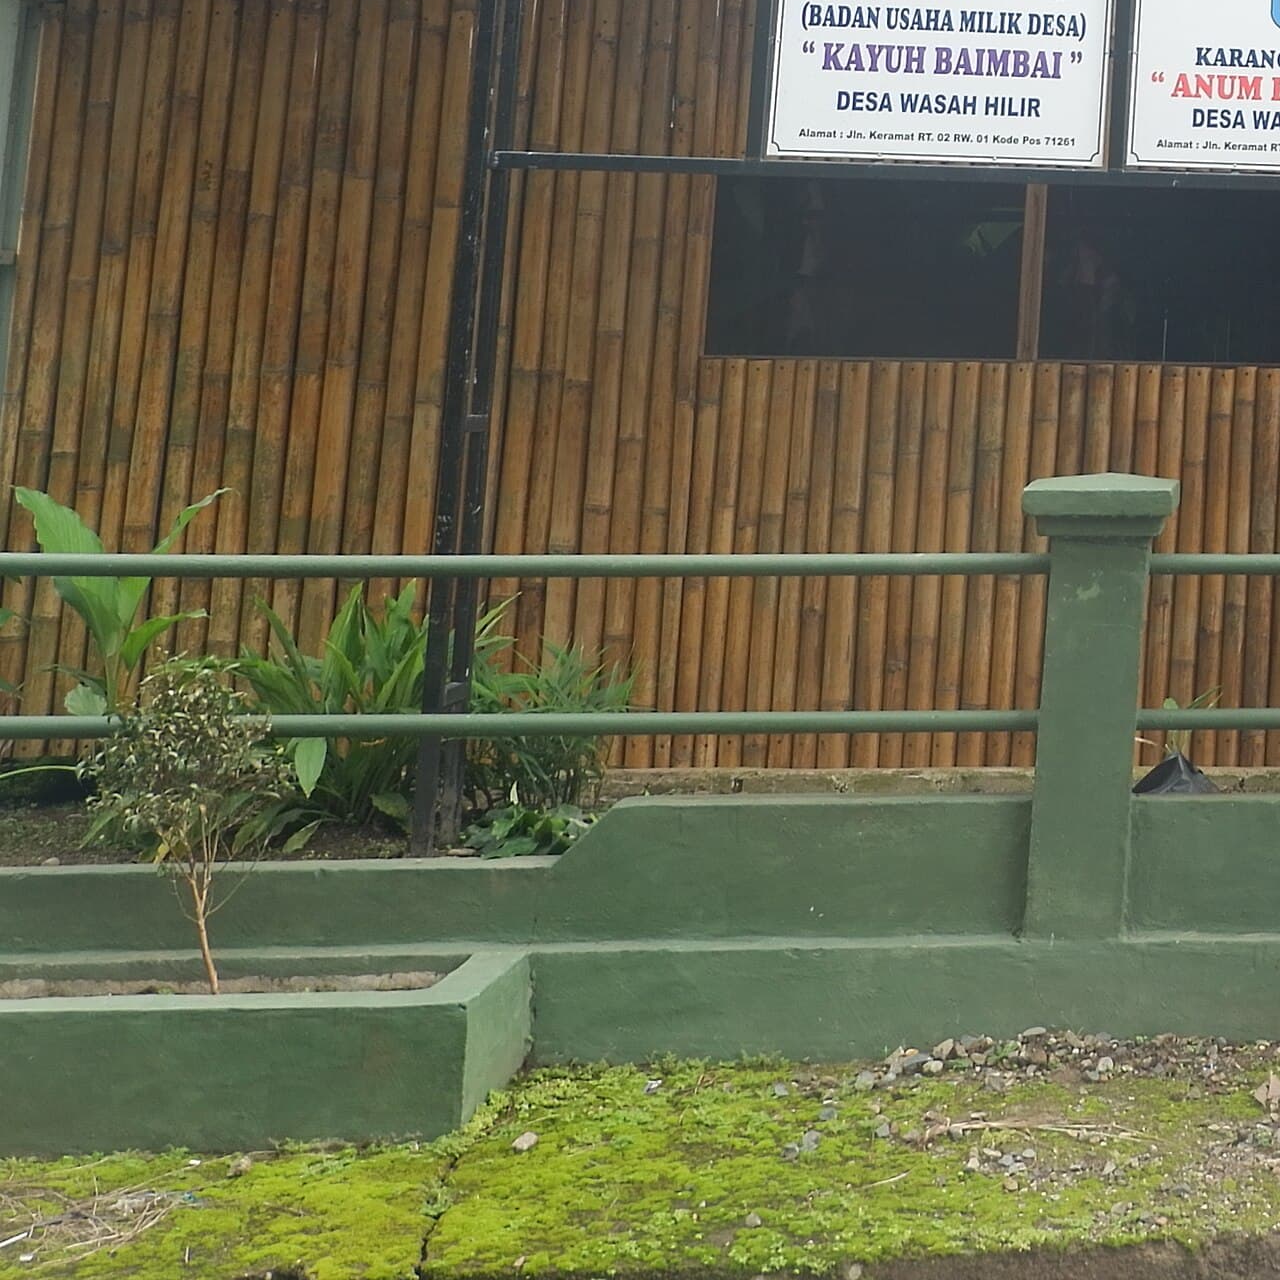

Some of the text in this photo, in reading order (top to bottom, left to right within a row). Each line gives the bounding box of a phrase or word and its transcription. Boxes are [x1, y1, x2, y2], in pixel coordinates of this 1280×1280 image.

[801, 1, 1087, 43] (BADAN USAHA MILIK DESA)
[821, 42, 1063, 80] KAYUH BAIMBAI
[1170, 72, 1264, 101] ANUM
[836, 90, 1041, 118] DESA WASAH HILIR
[1192, 108, 1246, 130] DESA
[1156, 139, 1193, 149] Alamat
[1201, 140, 1221, 150] Jln.
[1223, 141, 1268, 152] Keramat
